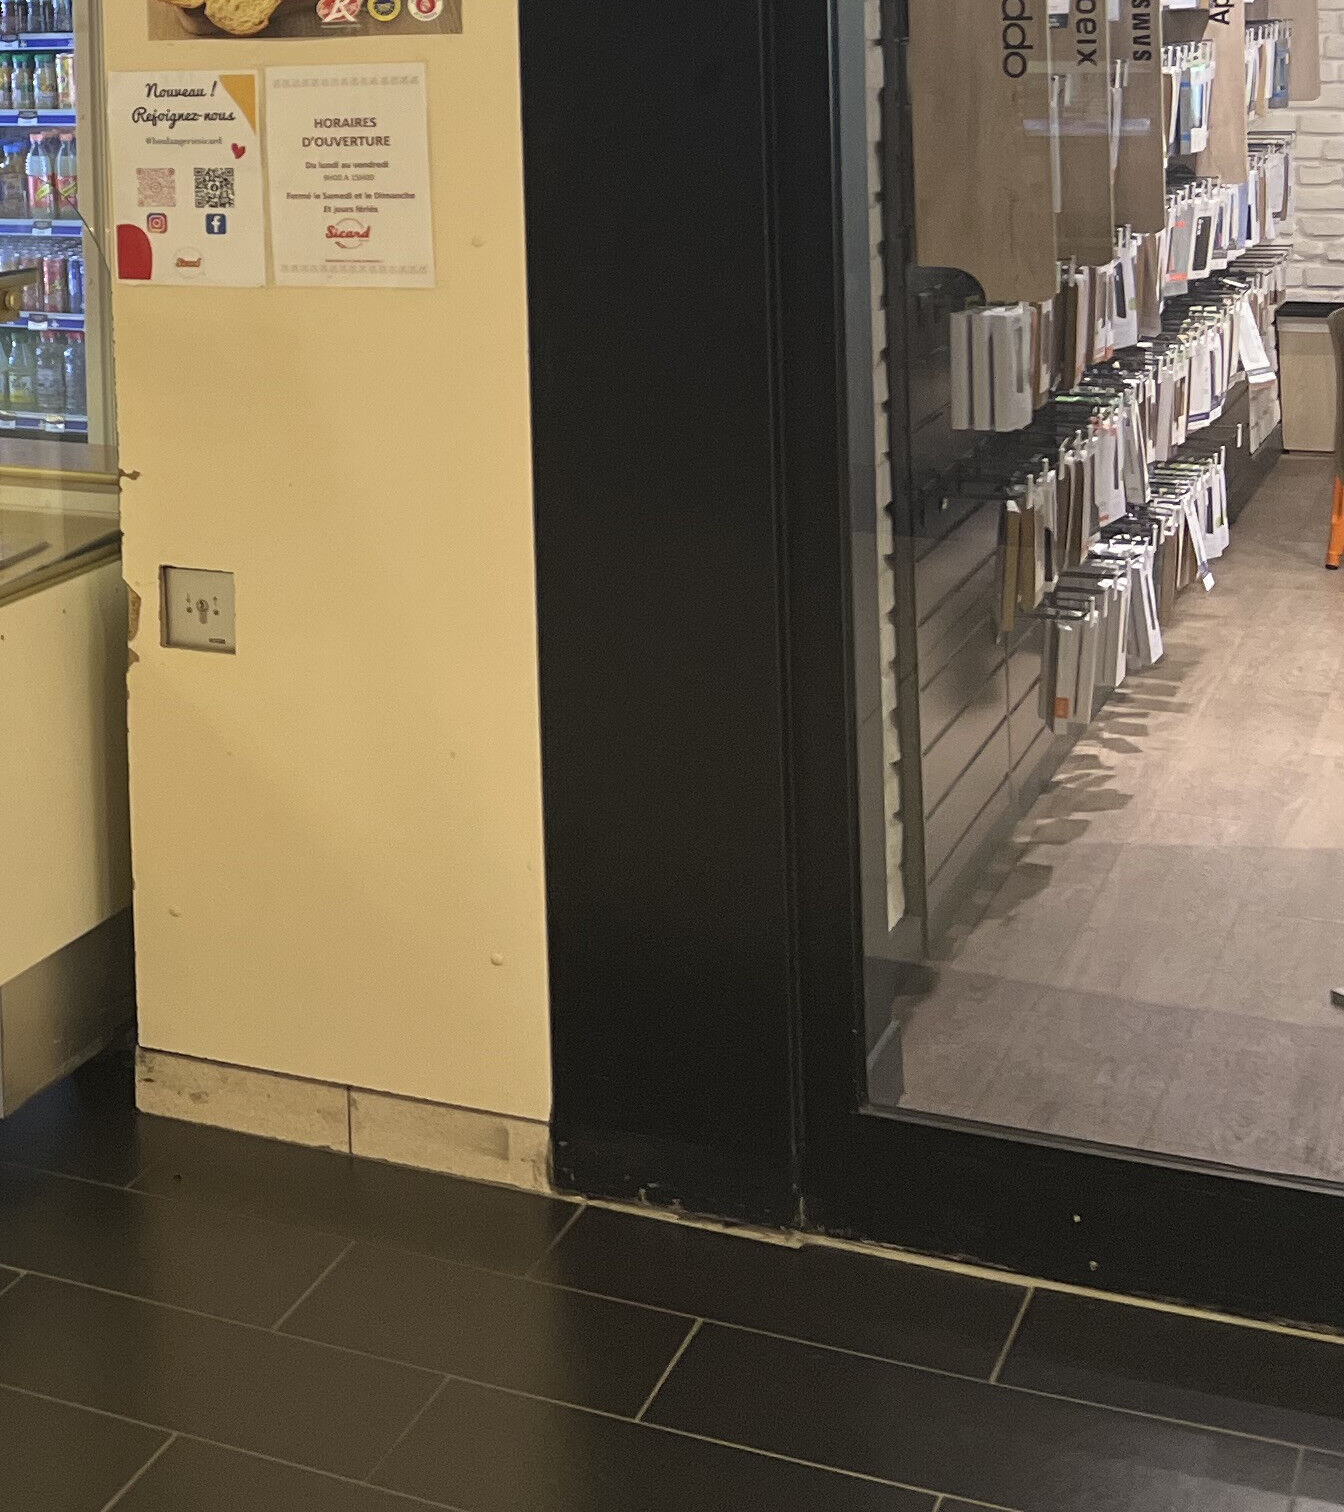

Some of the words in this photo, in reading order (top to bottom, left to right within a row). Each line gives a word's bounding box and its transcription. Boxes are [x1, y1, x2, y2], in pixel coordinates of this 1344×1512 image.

[145, 82, 207, 99] Nouveau
[131, 106, 236, 130] Rejoignez-nous
[313, 117, 378, 129] HORAIRES
[301, 136, 392, 148] D'OUVERTURE
[325, 224, 372, 239] Sicard
